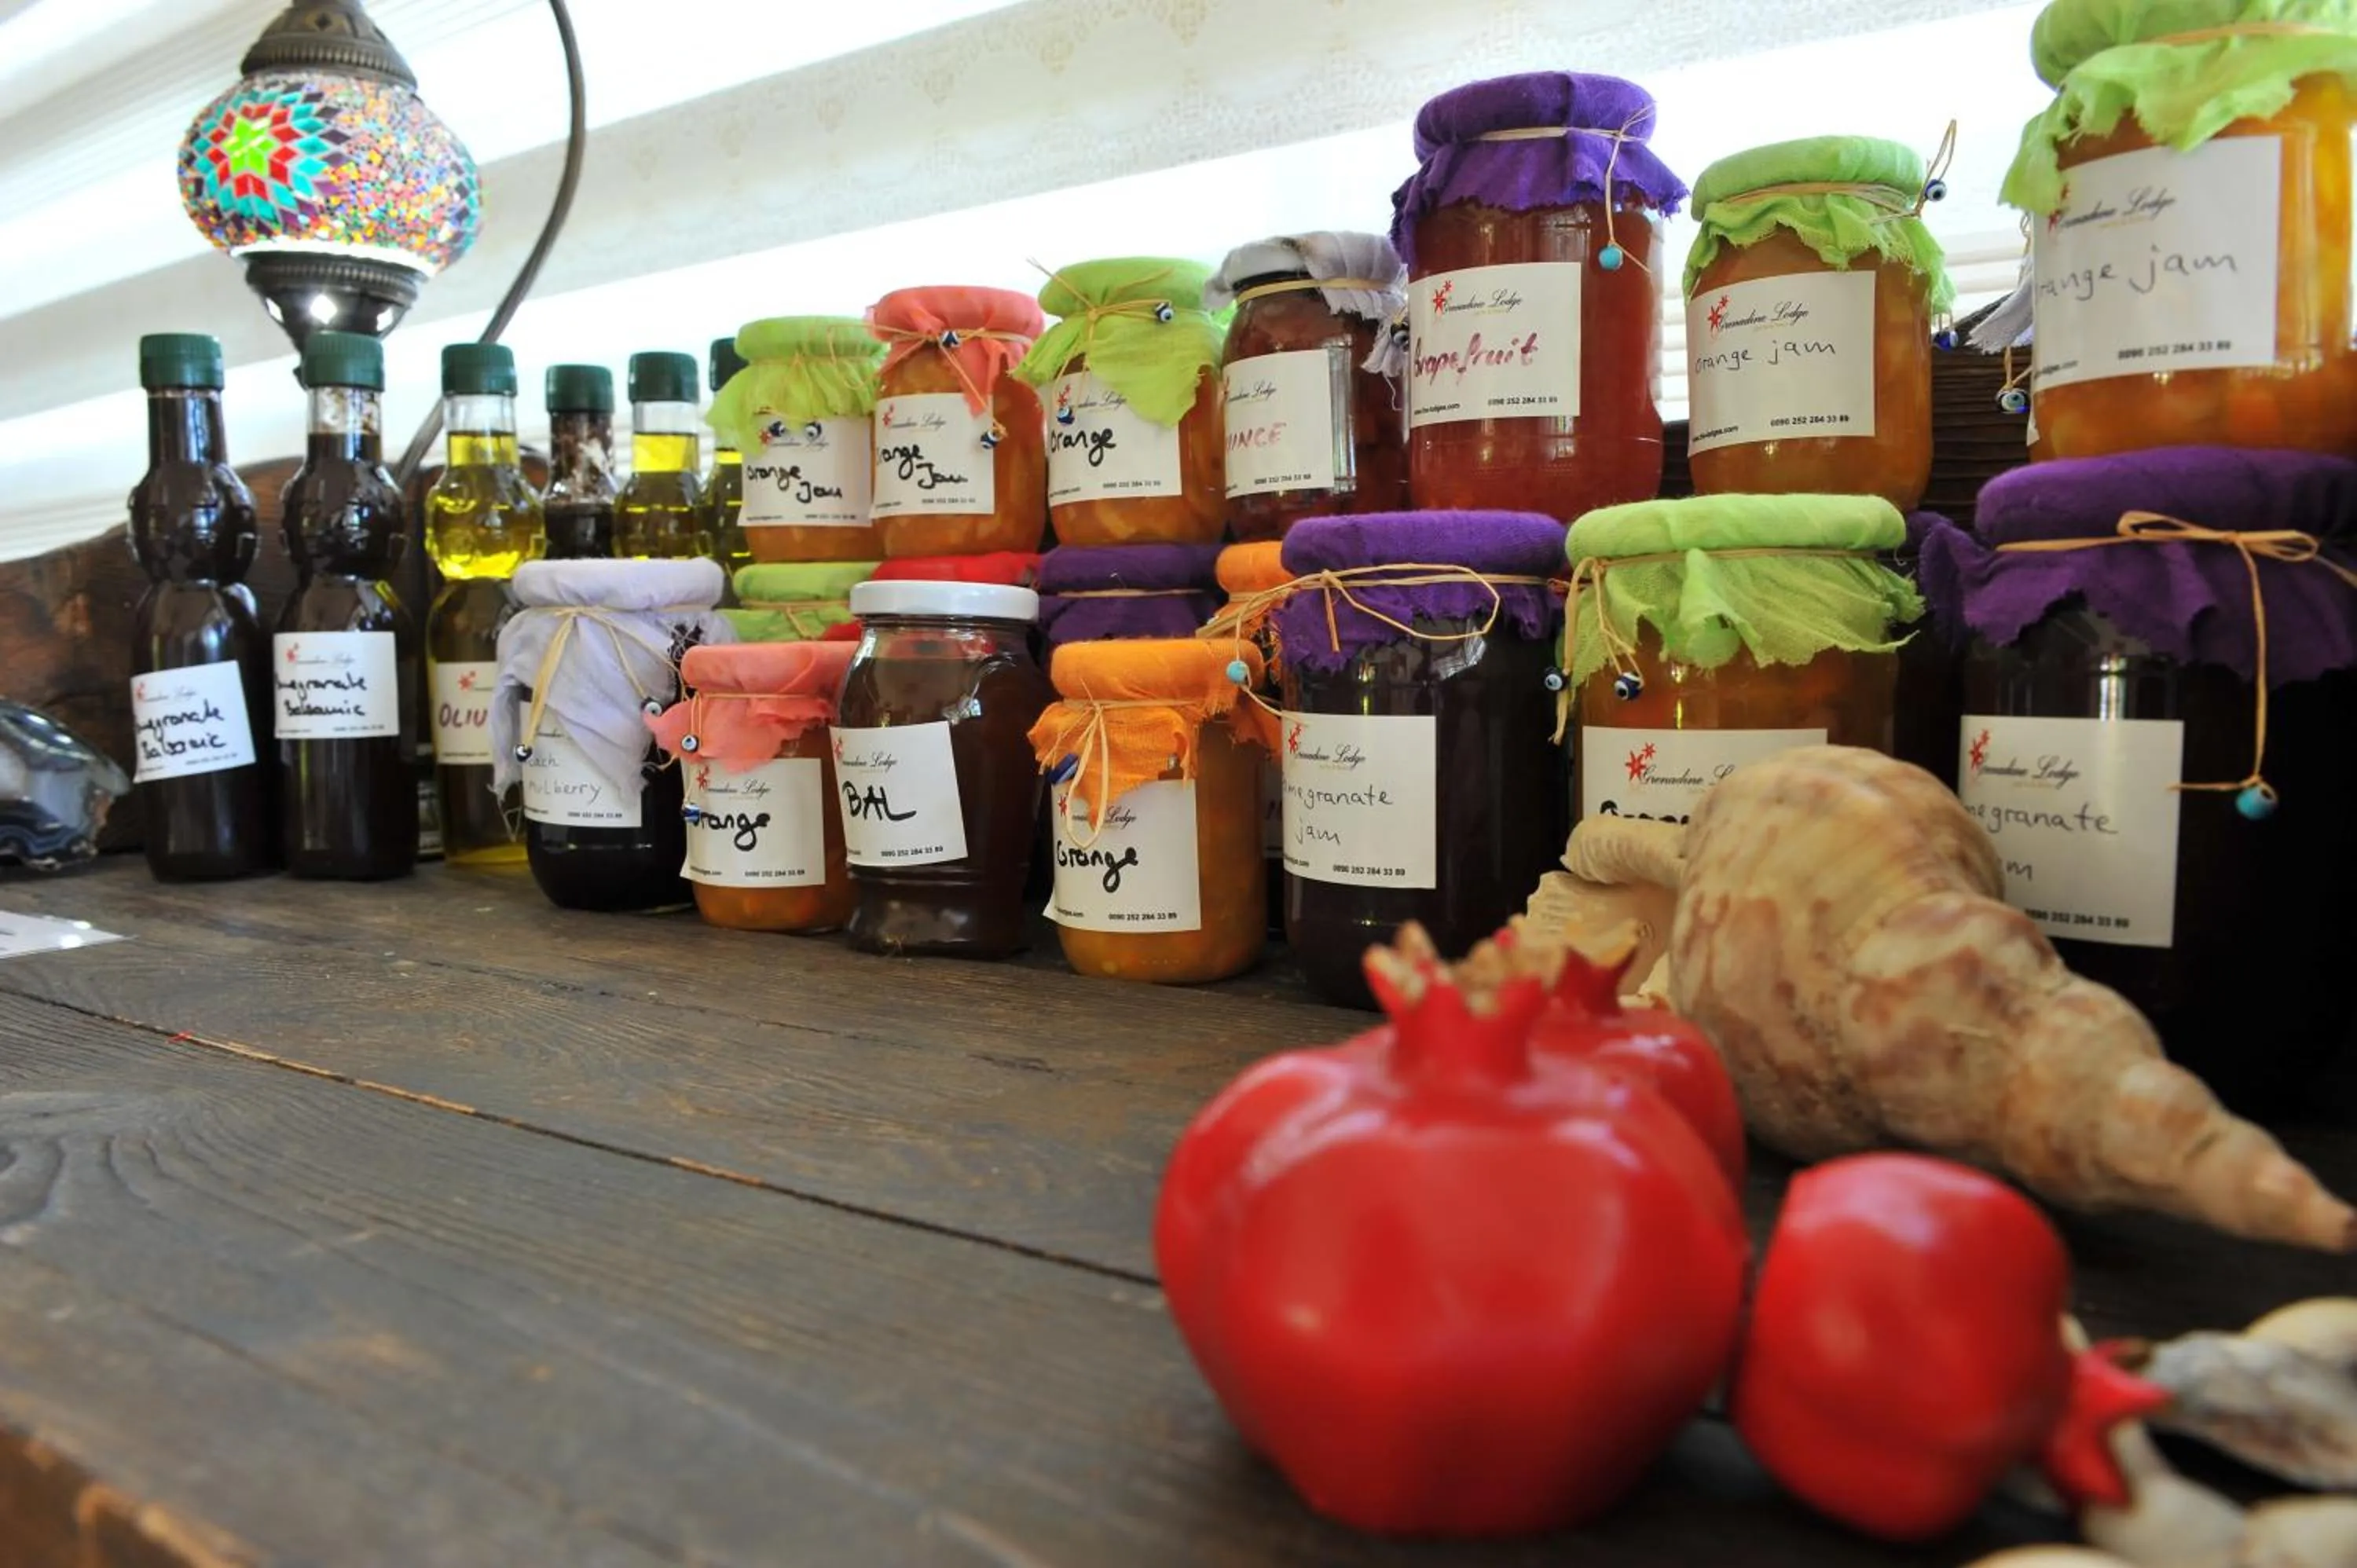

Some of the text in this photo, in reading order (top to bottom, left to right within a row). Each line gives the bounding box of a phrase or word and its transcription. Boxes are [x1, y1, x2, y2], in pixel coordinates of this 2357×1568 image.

[2128, 244, 2238, 294] jam
[1768, 339, 1836, 365] jam
[841, 780, 918, 822] BAL
